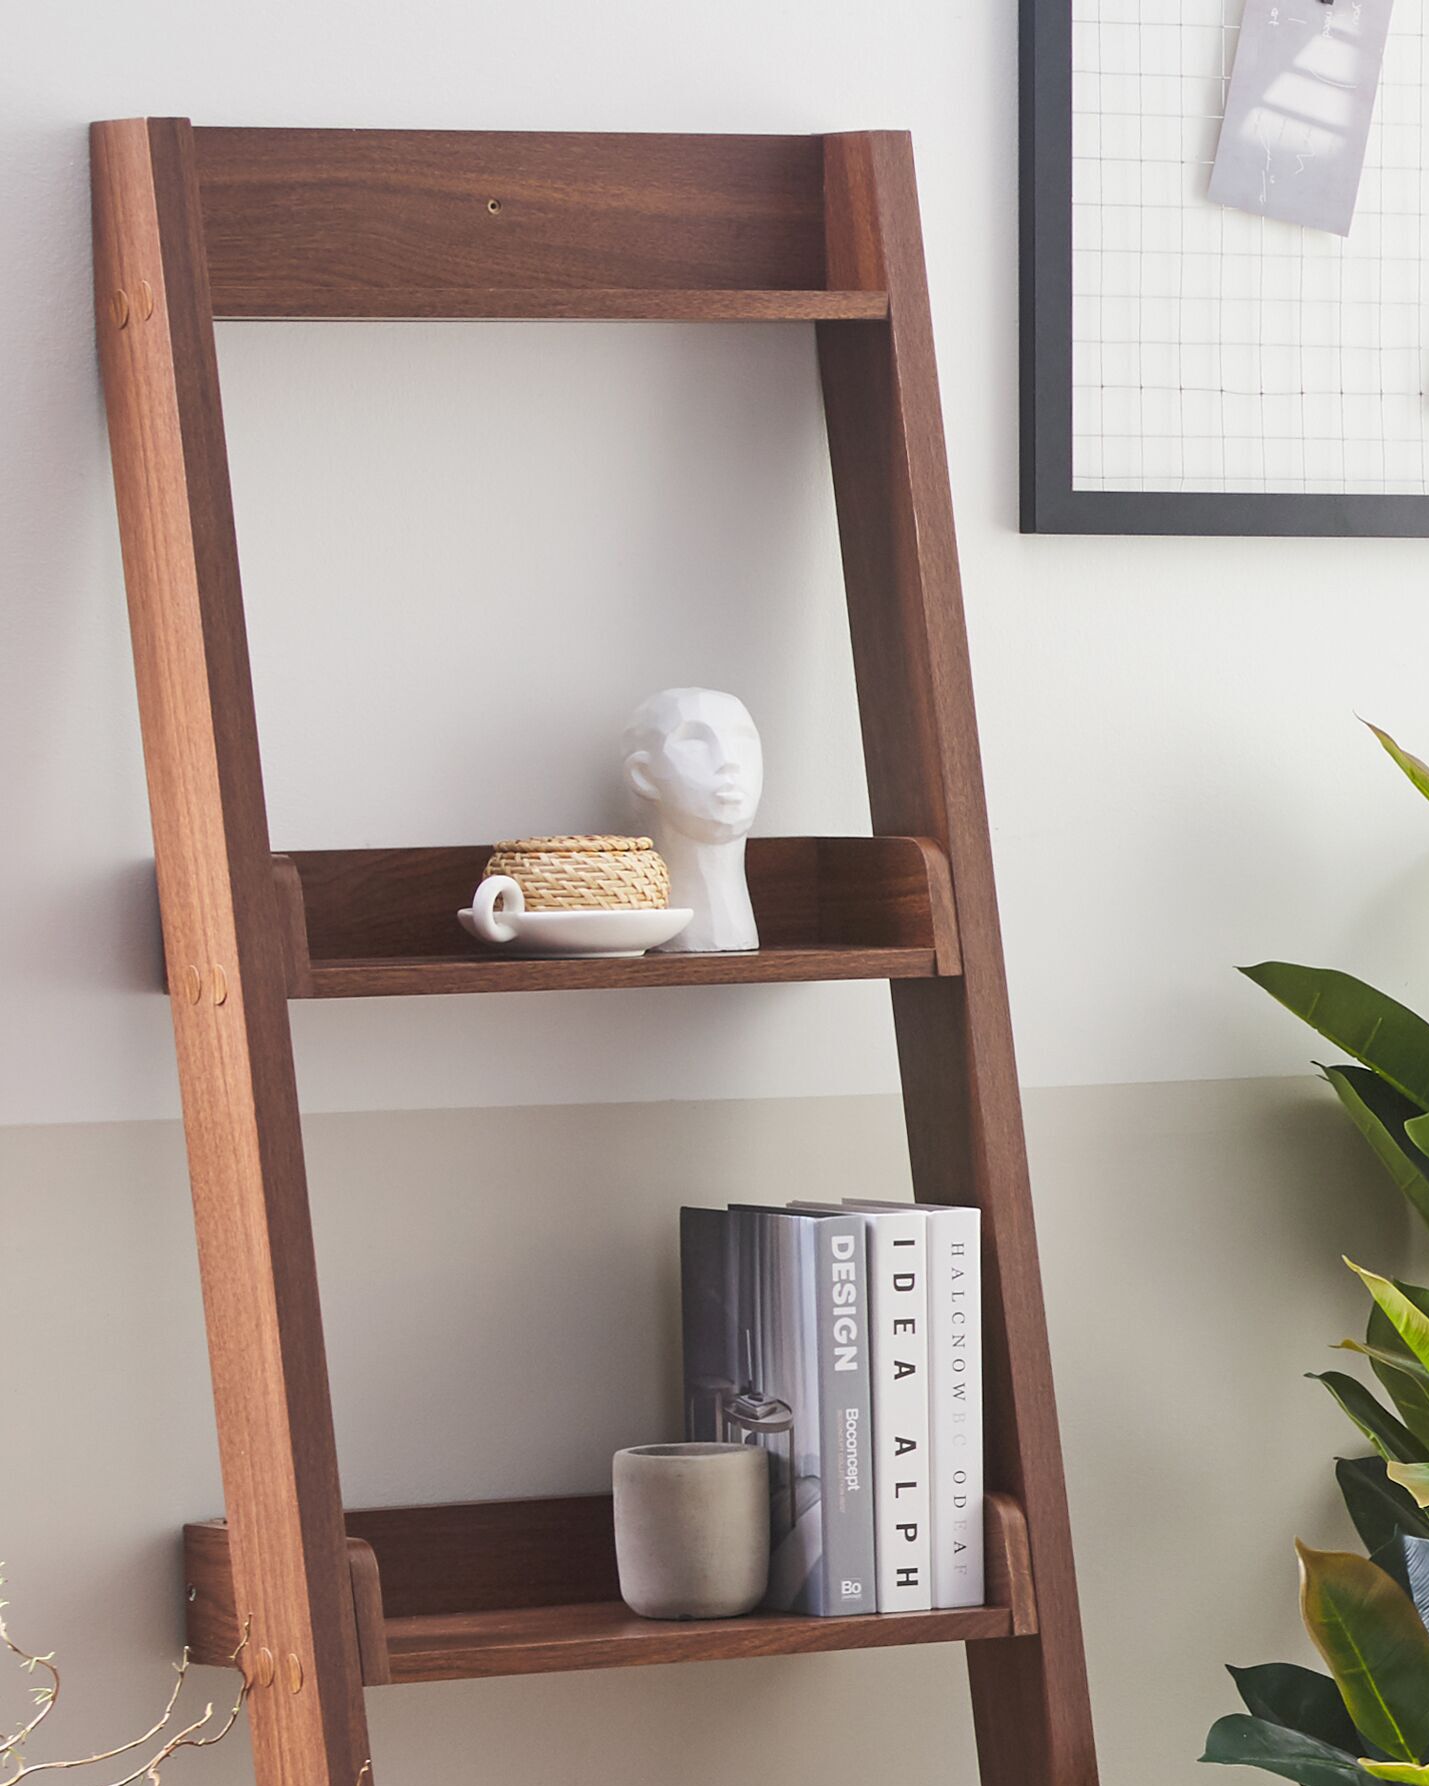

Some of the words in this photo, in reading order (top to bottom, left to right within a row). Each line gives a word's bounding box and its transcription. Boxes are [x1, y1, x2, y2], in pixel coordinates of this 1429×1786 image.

[831, 1235, 858, 1372] DESIGN
[893, 1239, 916, 1381] IDEA
[894, 1436, 919, 1587] ALPH
